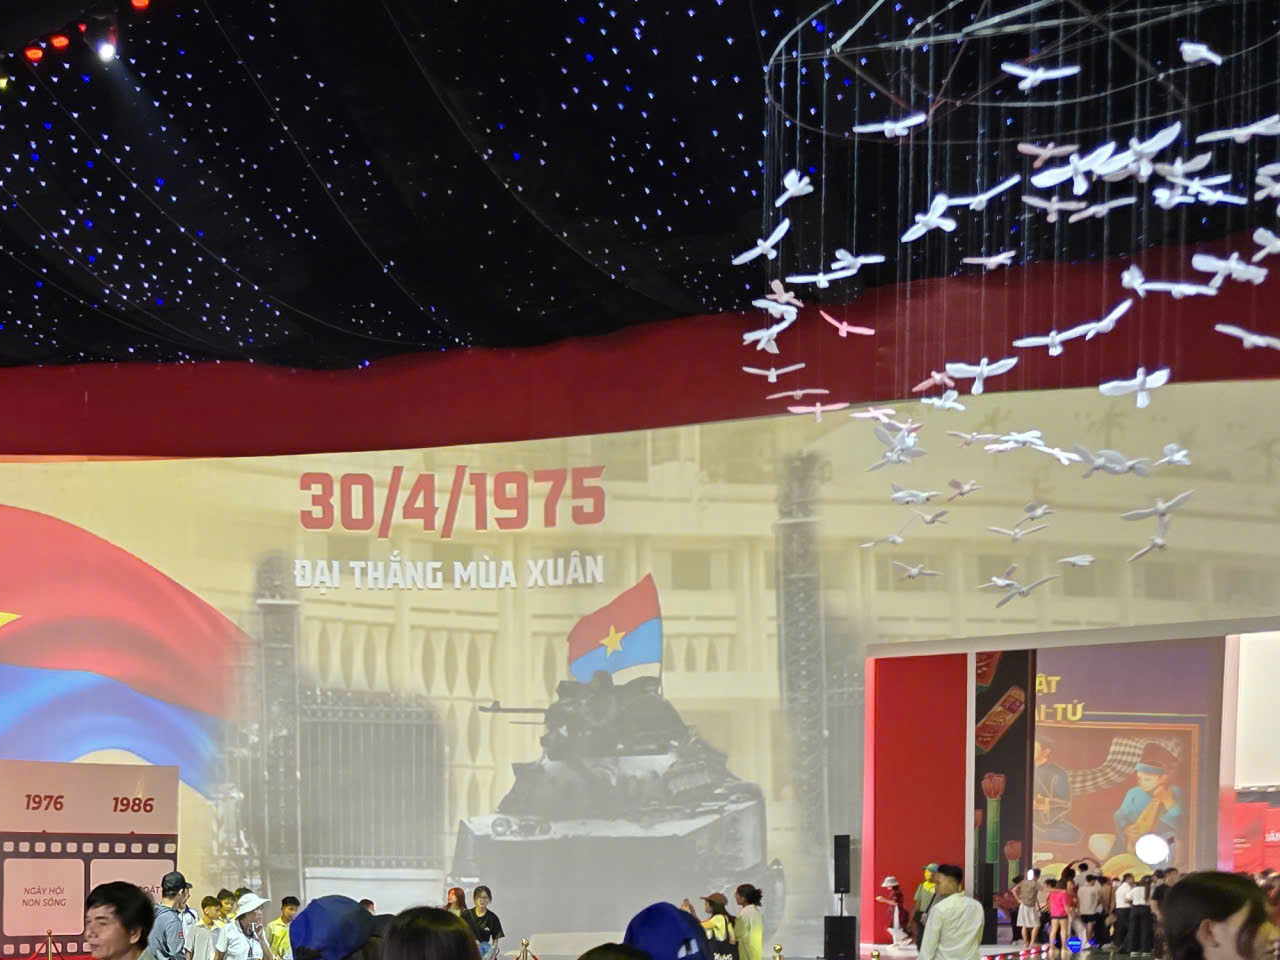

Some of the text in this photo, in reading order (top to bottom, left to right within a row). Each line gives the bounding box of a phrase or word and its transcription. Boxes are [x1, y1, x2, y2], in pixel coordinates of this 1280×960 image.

[299, 465, 606, 539] 30/4/1975
[294, 550, 605, 595] ĐẠI THẮNG MÙA XUÂN
[24, 793, 65, 812] 1976
[112, 796, 156, 814] 1986
[22, 898, 42, 907] NON
